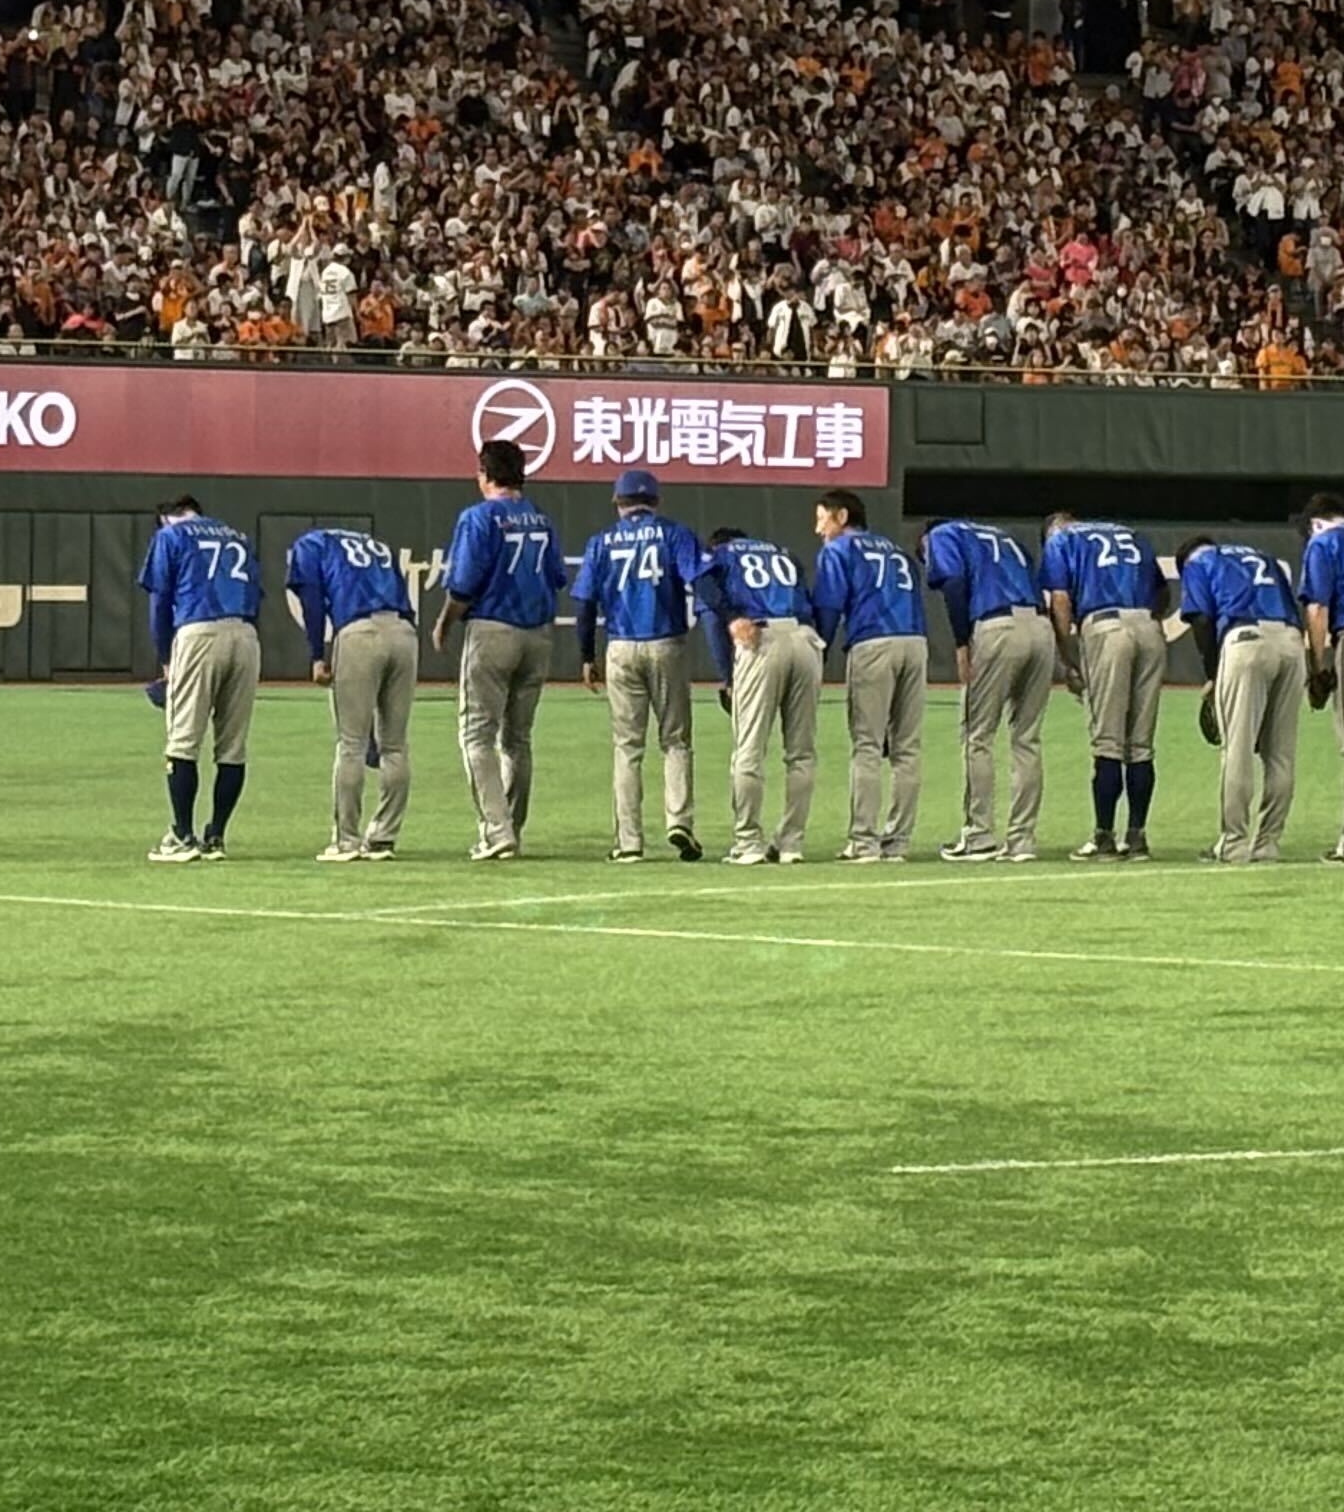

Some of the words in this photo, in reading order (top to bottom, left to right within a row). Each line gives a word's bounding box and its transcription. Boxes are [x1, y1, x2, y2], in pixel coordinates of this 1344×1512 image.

[572, 395, 864, 469] 東光電気工事
[197, 540, 249, 583] 72
[340, 538, 392, 568] 89
[504, 531, 549, 575] 77
[610, 544, 664, 593] 74
[739, 553, 798, 589] 80
[863, 551, 913, 591] 73
[1088, 533, 1141, 568] 25
